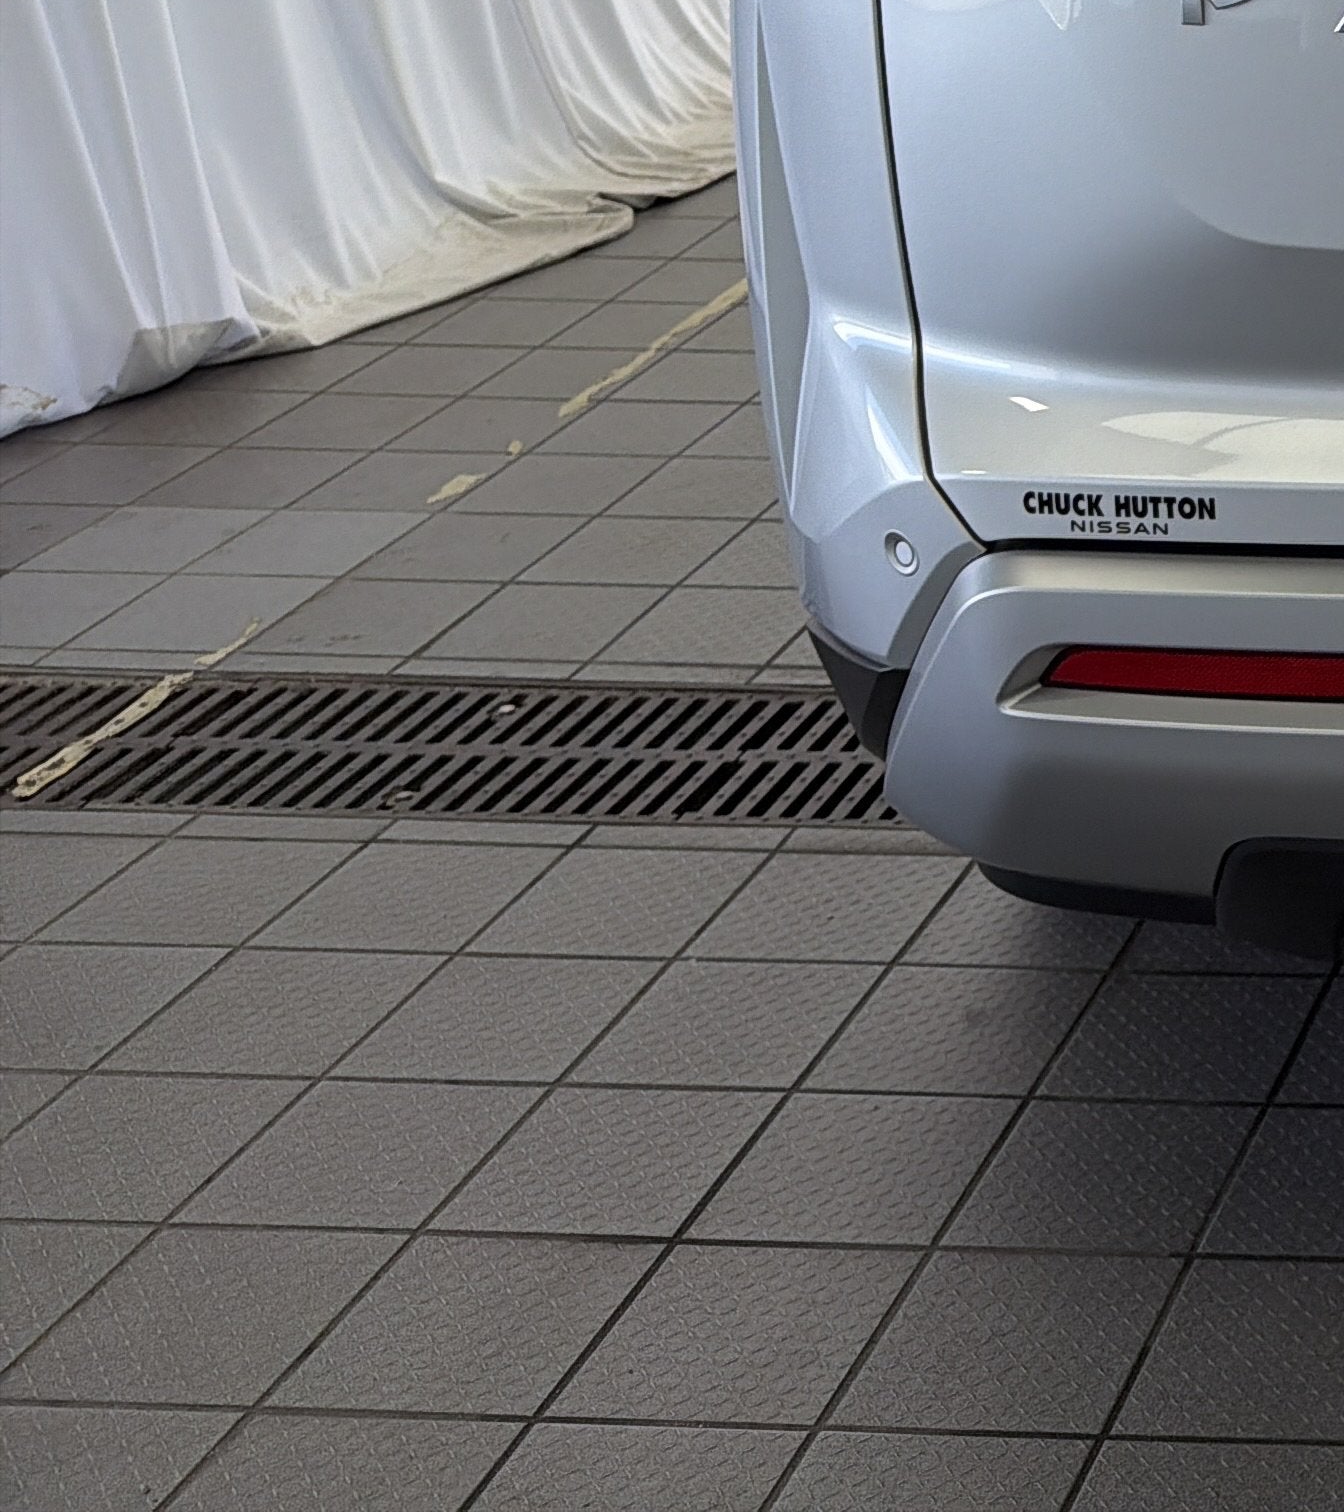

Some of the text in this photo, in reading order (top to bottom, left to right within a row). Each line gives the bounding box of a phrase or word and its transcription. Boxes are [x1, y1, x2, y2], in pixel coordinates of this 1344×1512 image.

[1023, 491, 1216, 520] CHUCK HUTTON
[1070, 520, 1169, 535] NISSAN
